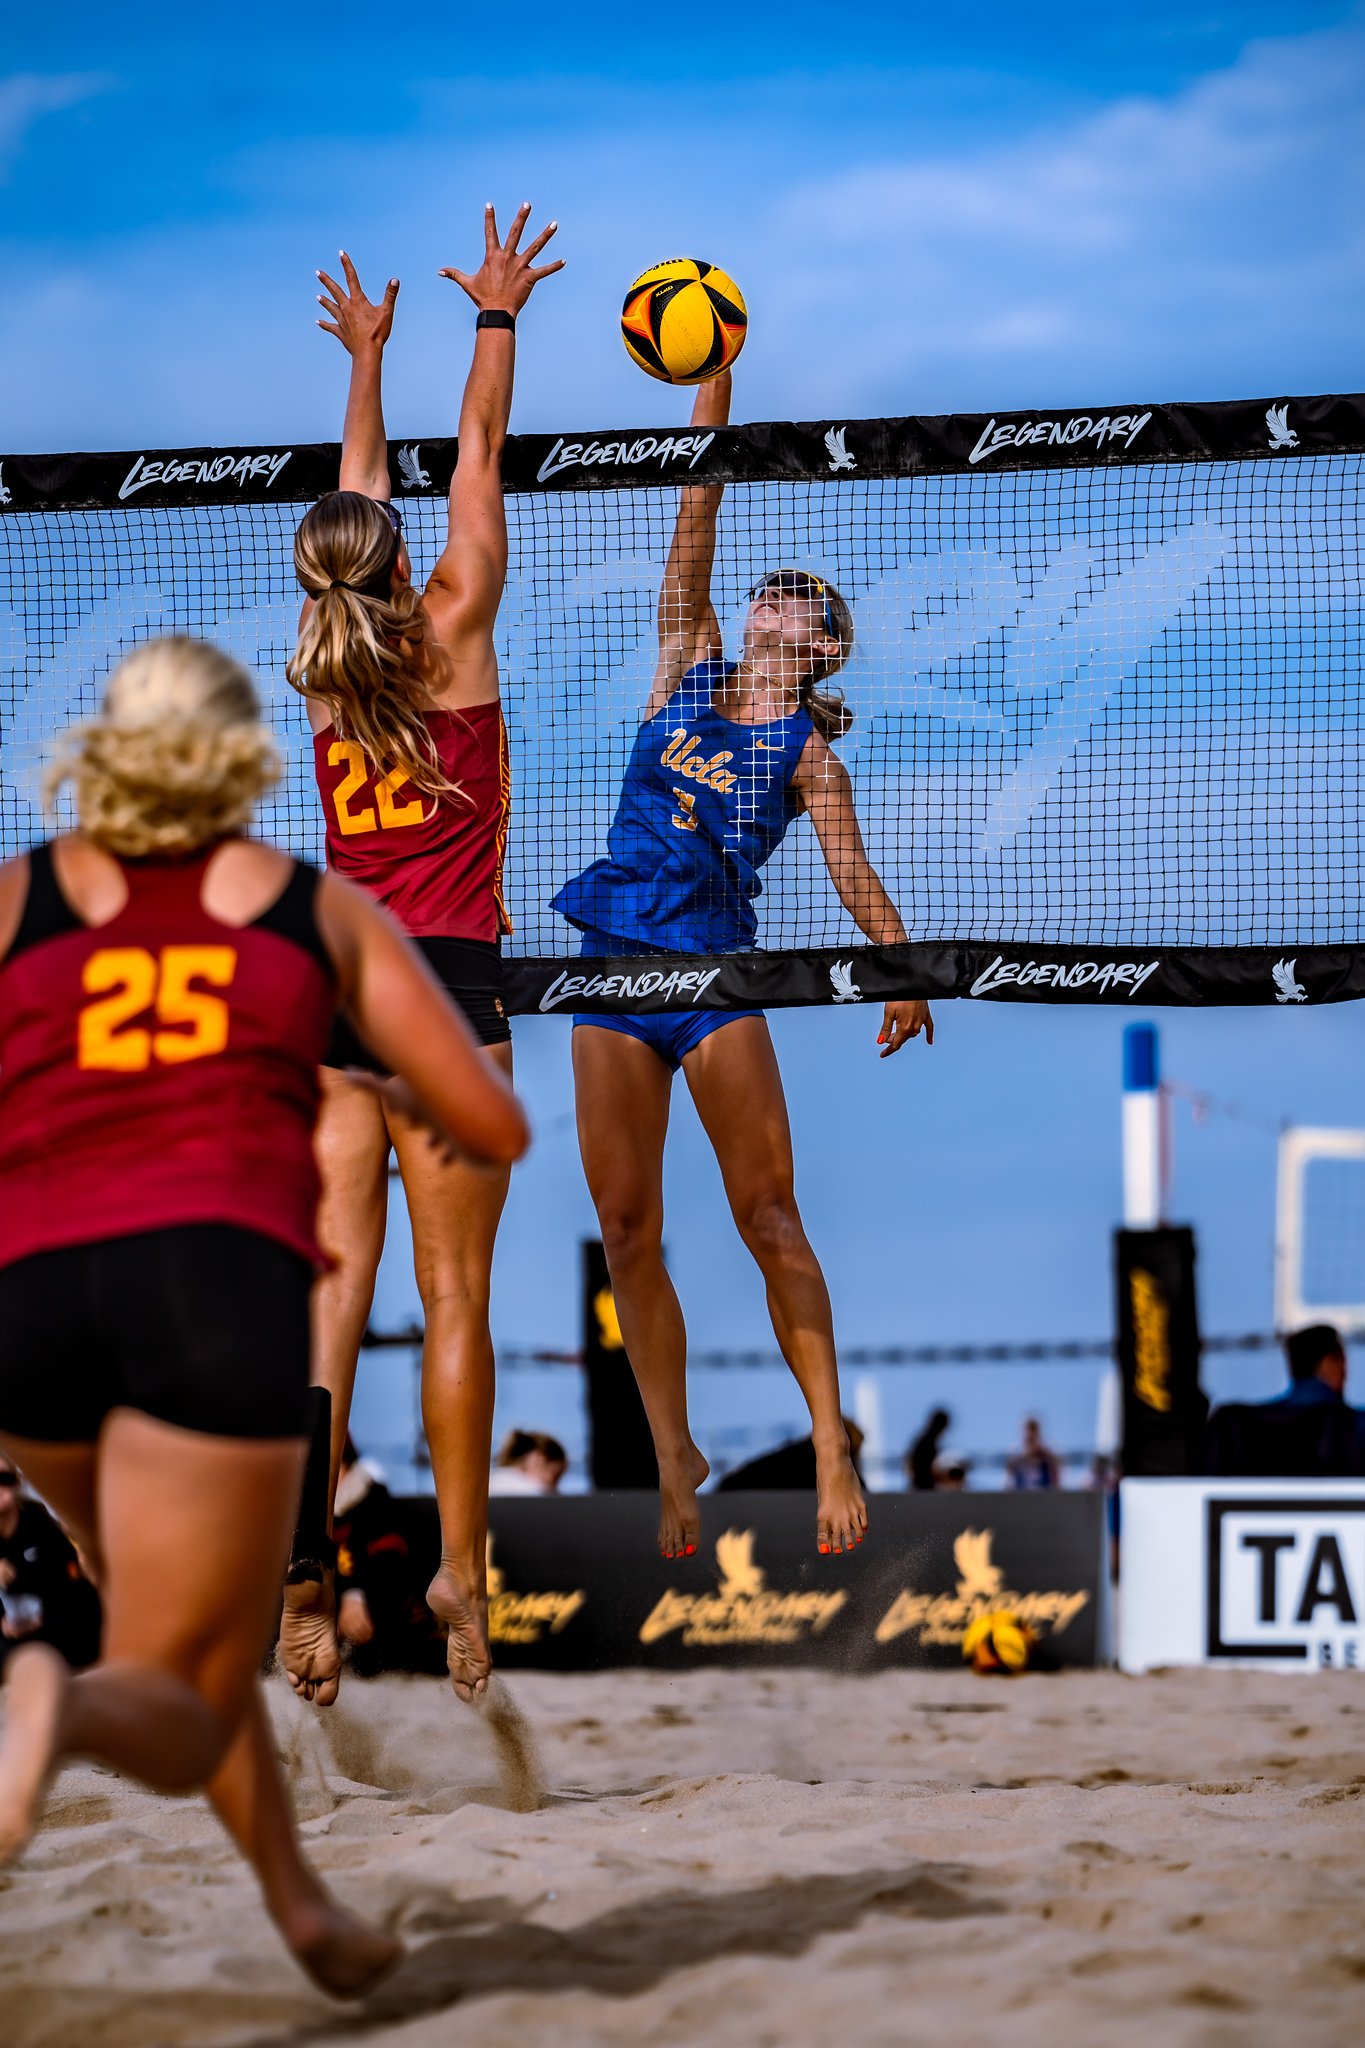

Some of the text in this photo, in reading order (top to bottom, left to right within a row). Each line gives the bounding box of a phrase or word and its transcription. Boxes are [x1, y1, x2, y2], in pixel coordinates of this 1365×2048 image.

[536, 431, 716, 483] LEGENDARY
[968, 411, 1153, 464] LEGENDARY
[118, 451, 292, 500] LEGENDARY
[327, 740, 424, 836] 22
[538, 967, 721, 1014] LEGENDARY
[970, 955, 1160, 997] LEGENDARY
[78, 945, 237, 1071] 25
[1242, 1534, 1357, 1624] TA
